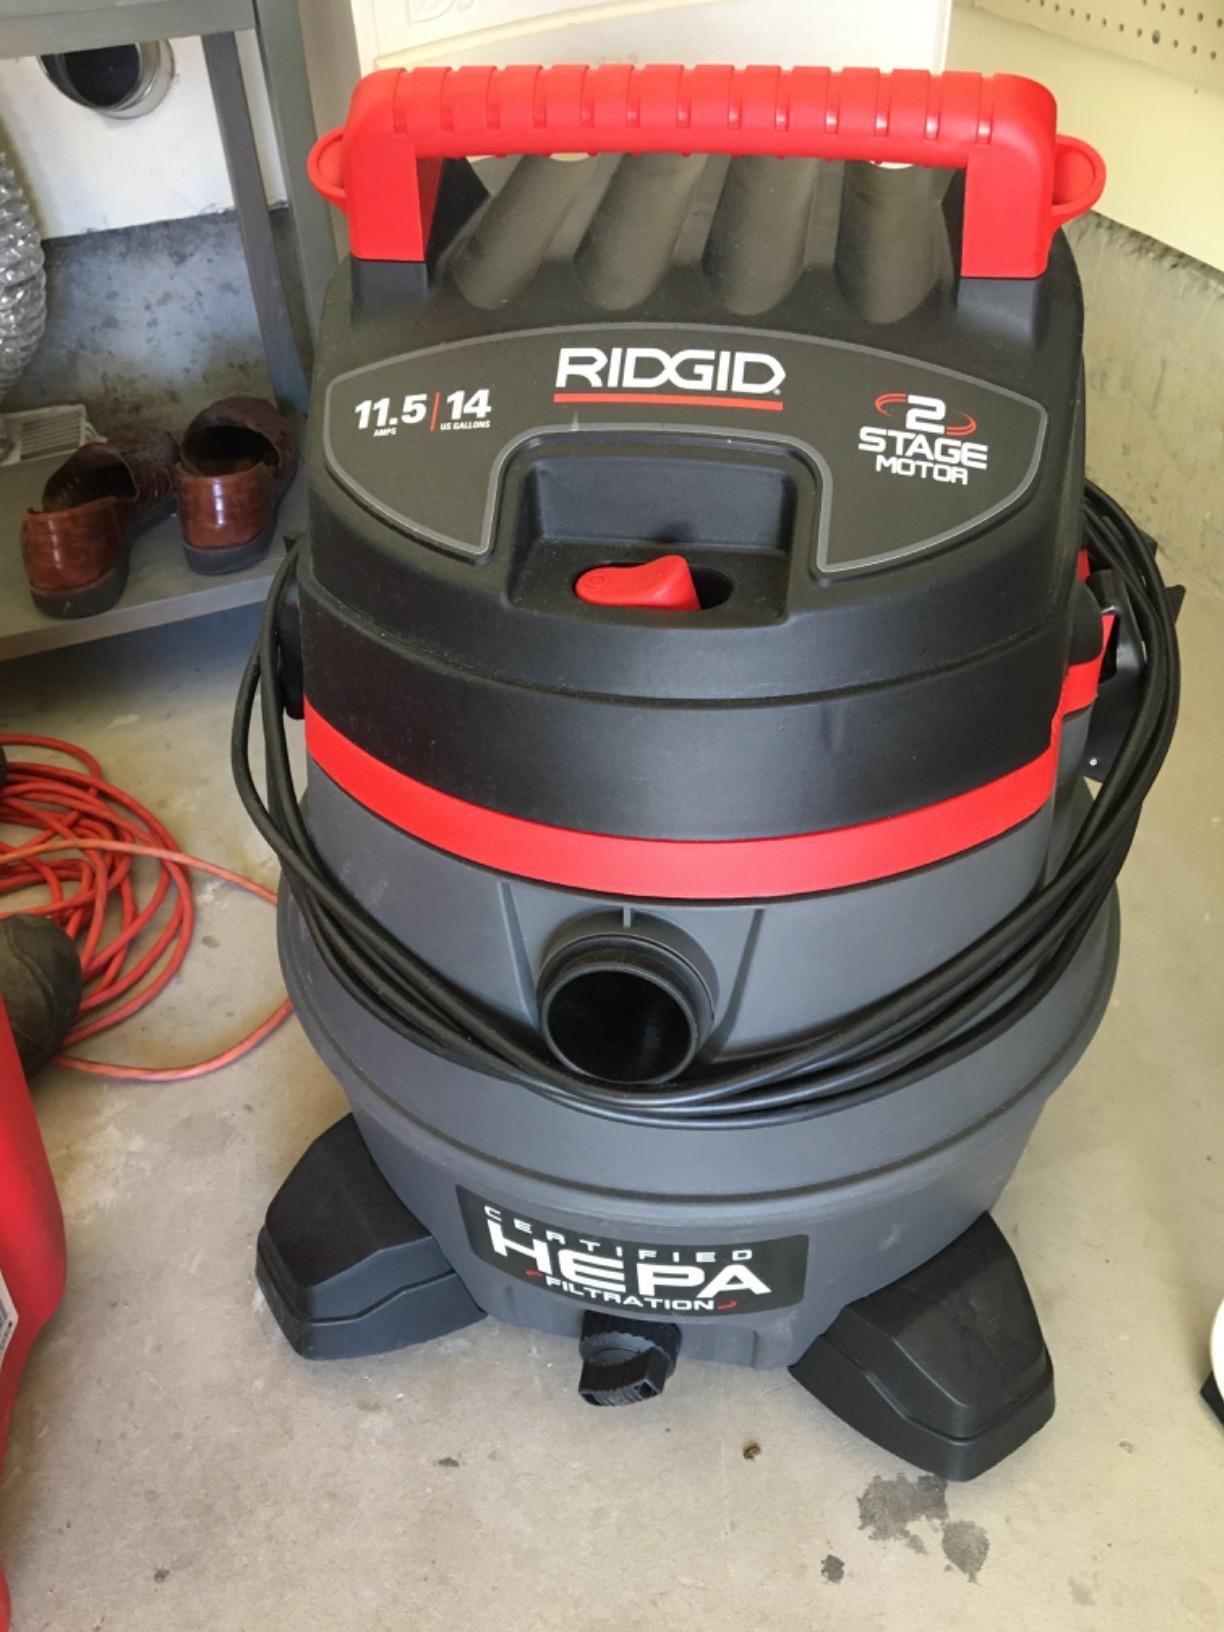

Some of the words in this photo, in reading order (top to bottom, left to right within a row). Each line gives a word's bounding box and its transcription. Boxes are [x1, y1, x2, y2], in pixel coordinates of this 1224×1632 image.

[555, 347, 787, 394] RIDGID
[354, 393, 428, 430] 11.5
[446, 388, 492, 421] 14
[905, 394, 947, 435] 2
[373, 427, 397, 437] AMPS
[453, 420, 491, 430] GALLONS
[858, 425, 989, 471] STAGE
[875, 454, 969, 486] MOTOR
[483, 1205, 753, 1263] CERTIFIED
[486, 1218, 773, 1300] HEPA
[546, 1276, 715, 1311] FILTRATION
